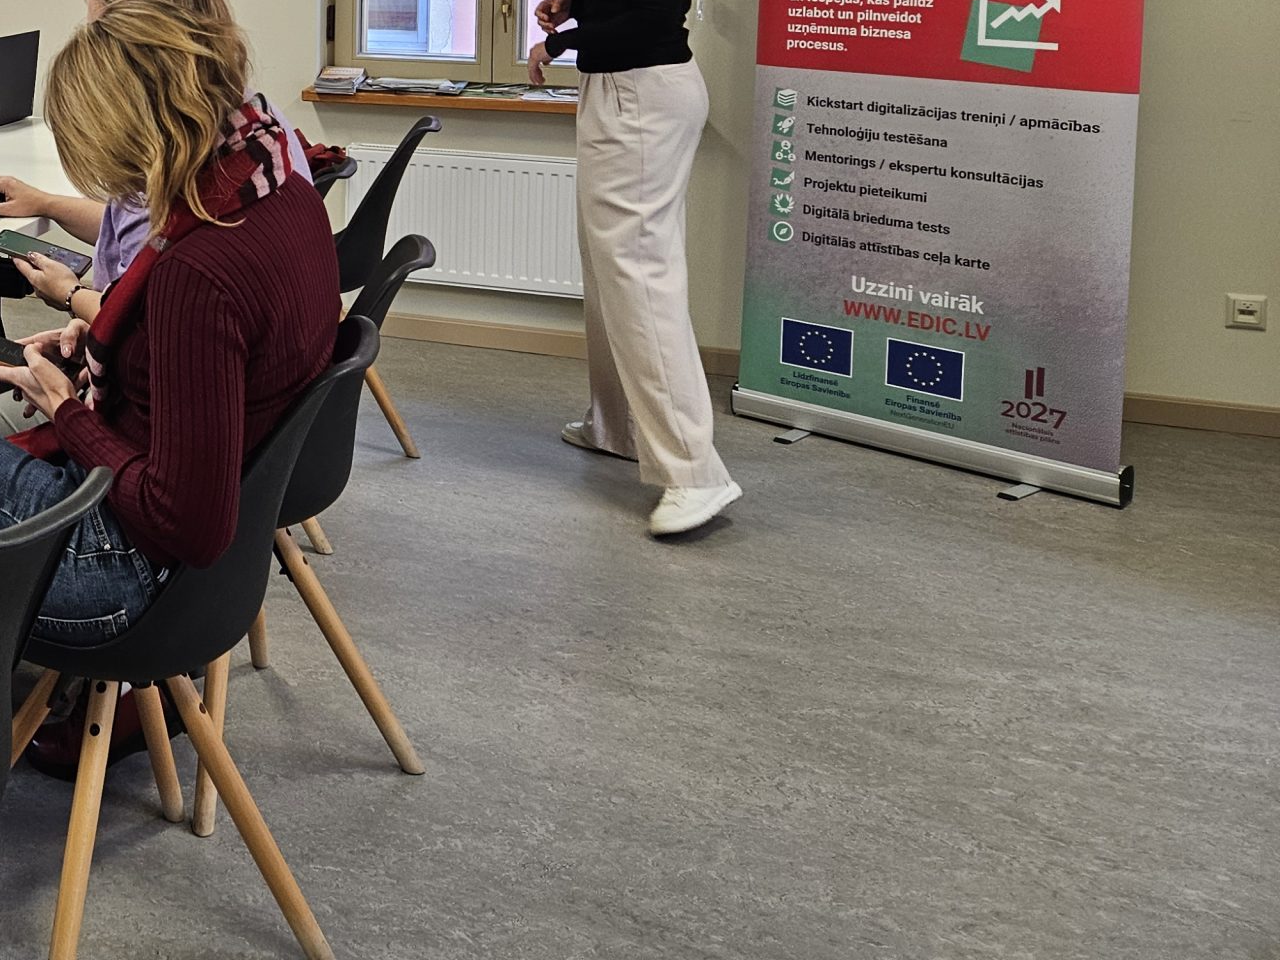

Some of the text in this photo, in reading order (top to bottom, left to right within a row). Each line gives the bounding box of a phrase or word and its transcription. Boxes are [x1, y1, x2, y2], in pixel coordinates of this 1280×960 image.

[787, 6, 922, 24] uzlabot un pilnveidot
[787, 22, 912, 40] uzņēmuma biznesa
[786, 39, 848, 53] procesus.
[807, 95, 864, 111] Kickstart
[866, 100, 958, 121] digitalizācijas
[961, 109, 1006, 128] treniņi
[1019, 116, 1101, 134] apmācības
[806, 123, 948, 148] Tehnoloģiju testēšana
[805, 150, 876, 170] Mentorings
[888, 159, 947, 179] ekspertu
[950, 166, 1044, 189] konsultācijas
[803, 176, 928, 203] Projektu pieteikumi
[802, 204, 951, 236] Digitālā brieduma tests
[801, 230, 991, 271] Digitālās attīstības ceļa karte
[851, 275, 985, 315] Uzzini vairāk
[843, 299, 992, 342] WWW.EDIC.LV
[780, 376, 811, 390] Eiropas
[885, 398, 917, 411] Eiropas
[1000, 400, 1067, 430] 2027
